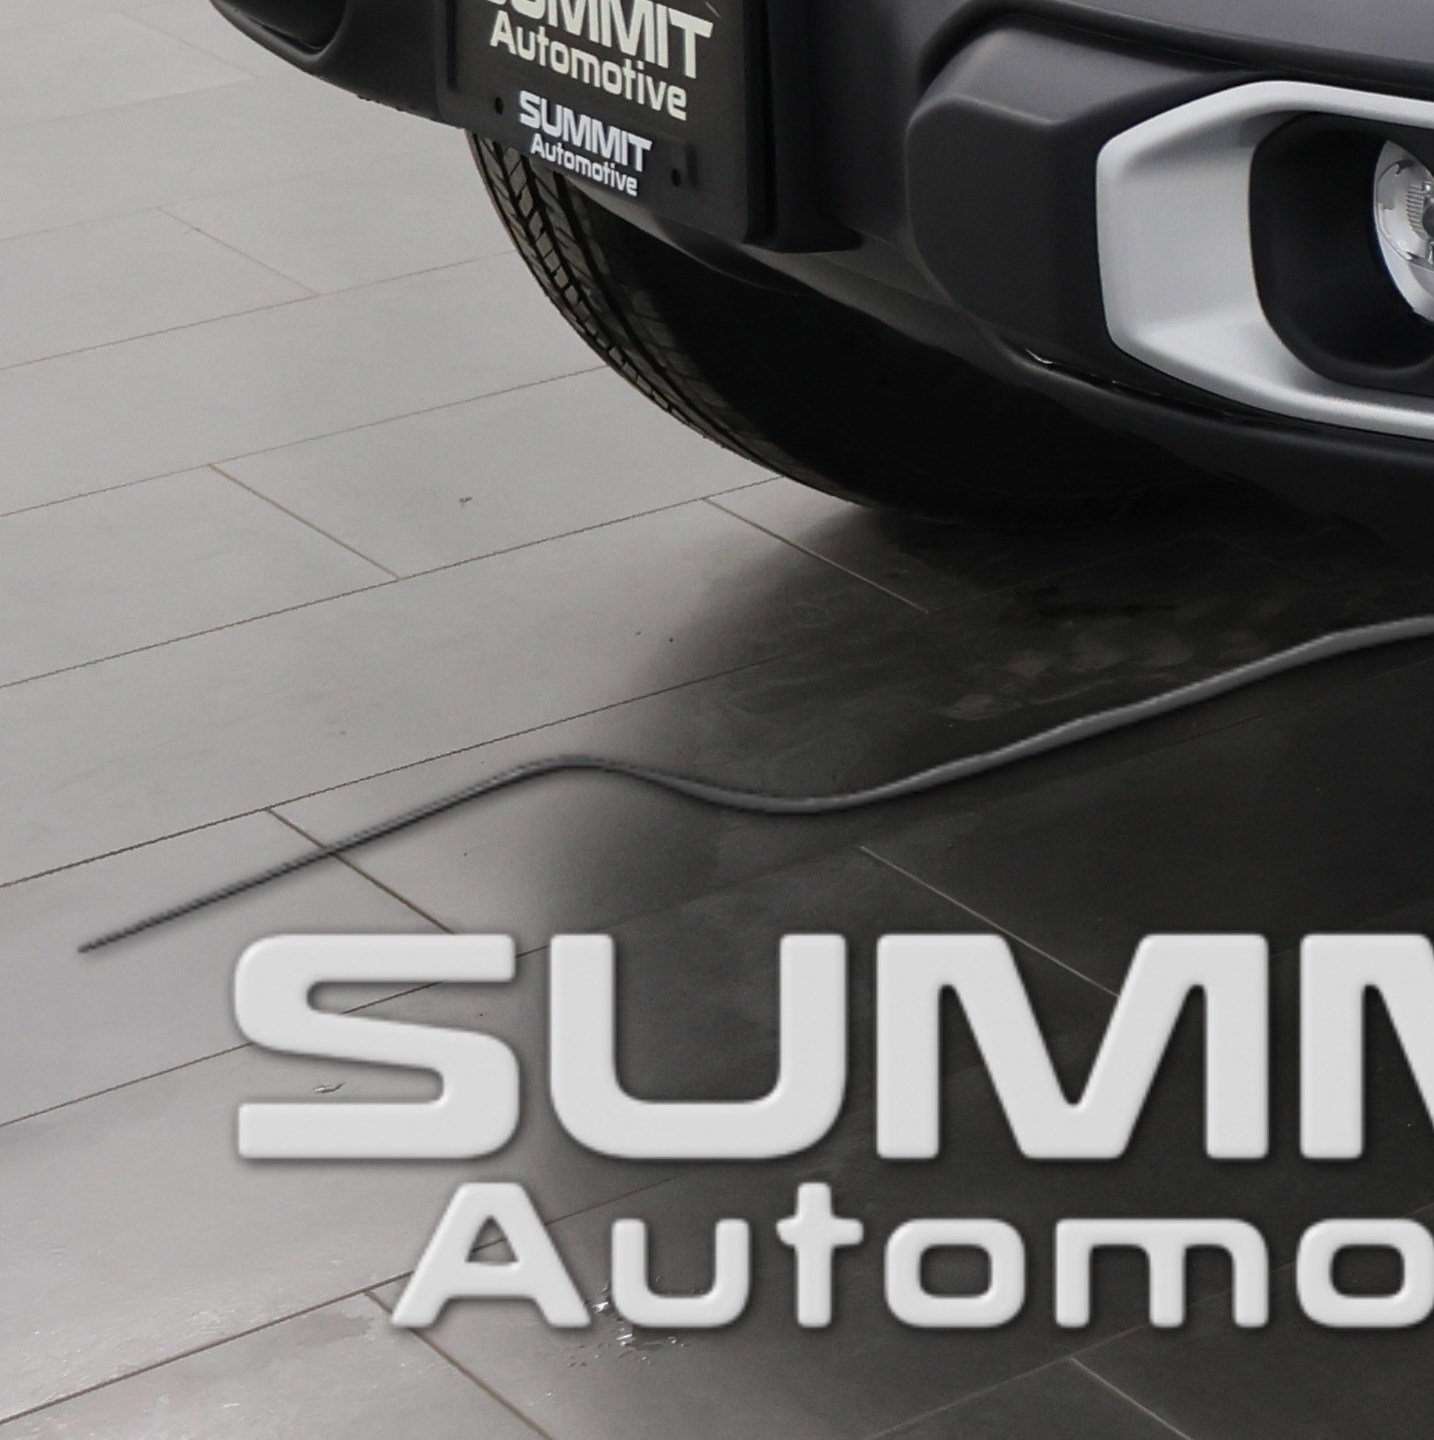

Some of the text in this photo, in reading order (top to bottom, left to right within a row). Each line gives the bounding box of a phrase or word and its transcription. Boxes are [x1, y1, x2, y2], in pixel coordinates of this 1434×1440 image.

[490, 9, 688, 121] Automotive
[518, 89, 652, 173] SUMMIT
[530, 132, 638, 197] Automotive
